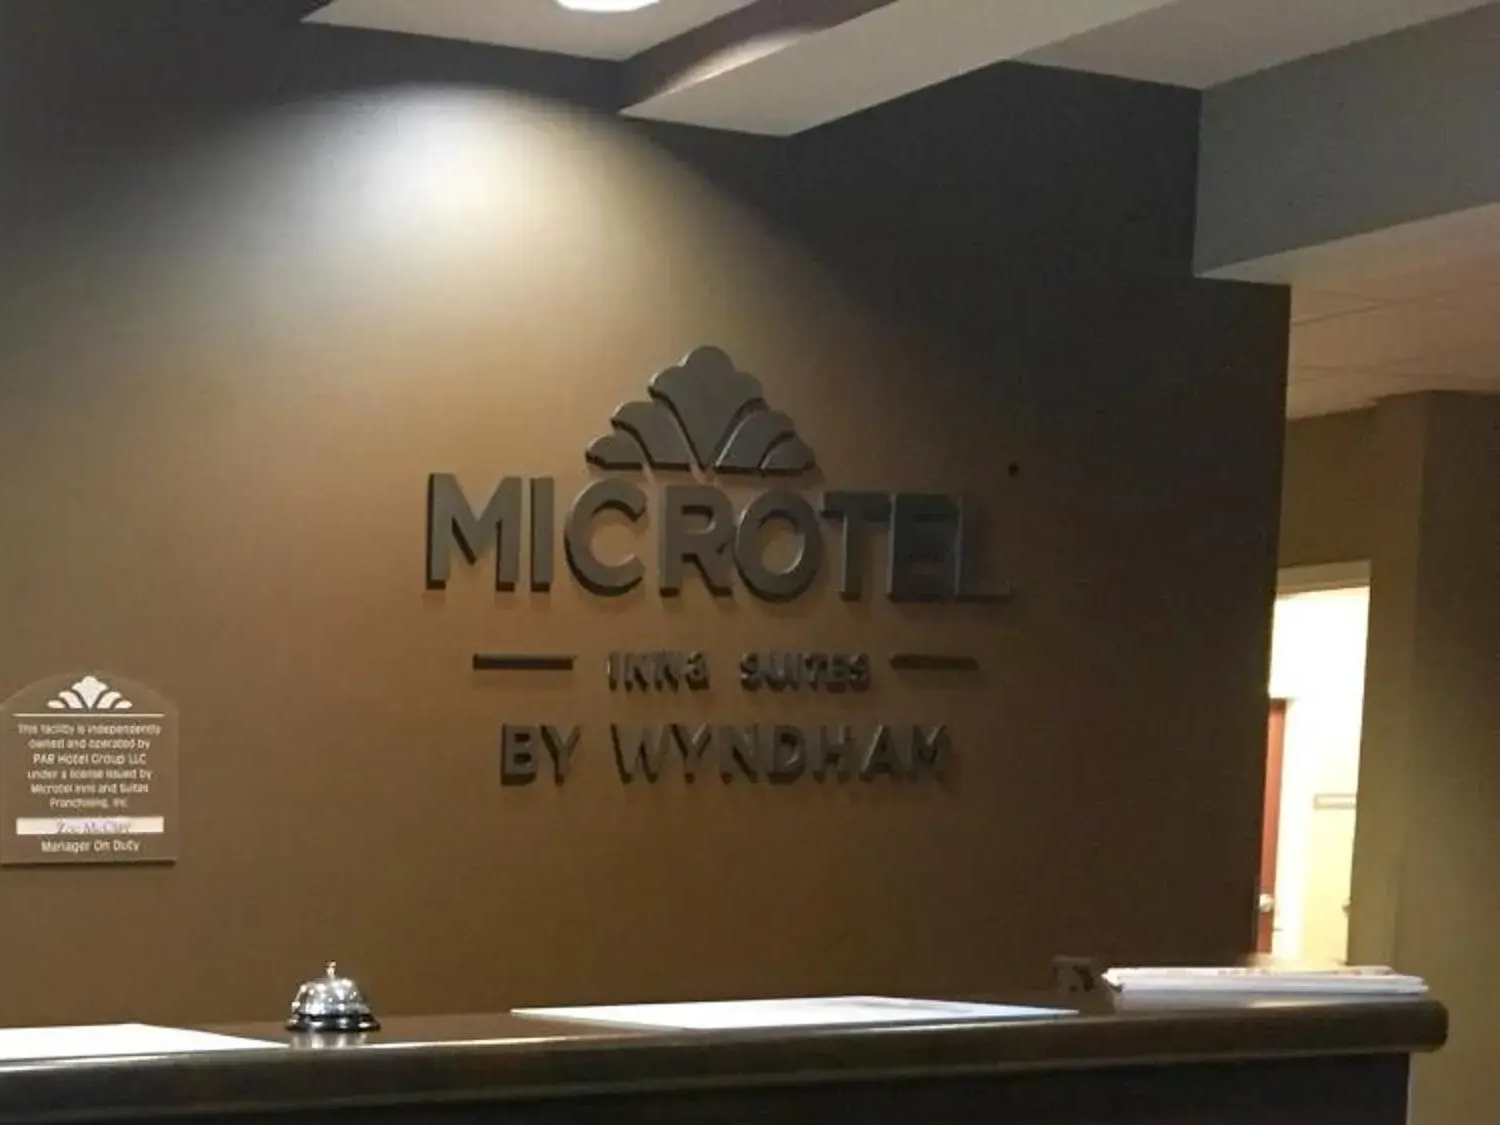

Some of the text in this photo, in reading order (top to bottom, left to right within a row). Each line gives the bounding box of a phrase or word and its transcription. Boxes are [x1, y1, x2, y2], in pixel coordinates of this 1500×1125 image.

[424, 472, 1016, 604] MICROTEL
[739, 652, 872, 693] SUITES
[18, 724, 37, 734] This
[41, 724, 74, 736] facility
[88, 723, 162, 736] independently
[28, 739, 150, 750] owned and operated by
[58, 754, 88, 765] Hotel
[91, 754, 124, 766] Group
[128, 754, 147, 765] LLC
[499, 722, 953, 787] BY WYNDHAM
[27, 770, 58, 779] under
[139, 770, 152, 781] by
[31, 783, 73, 793] Microtel
[99, 784, 116, 793] and
[41, 839, 141, 853] Manager On Duty
